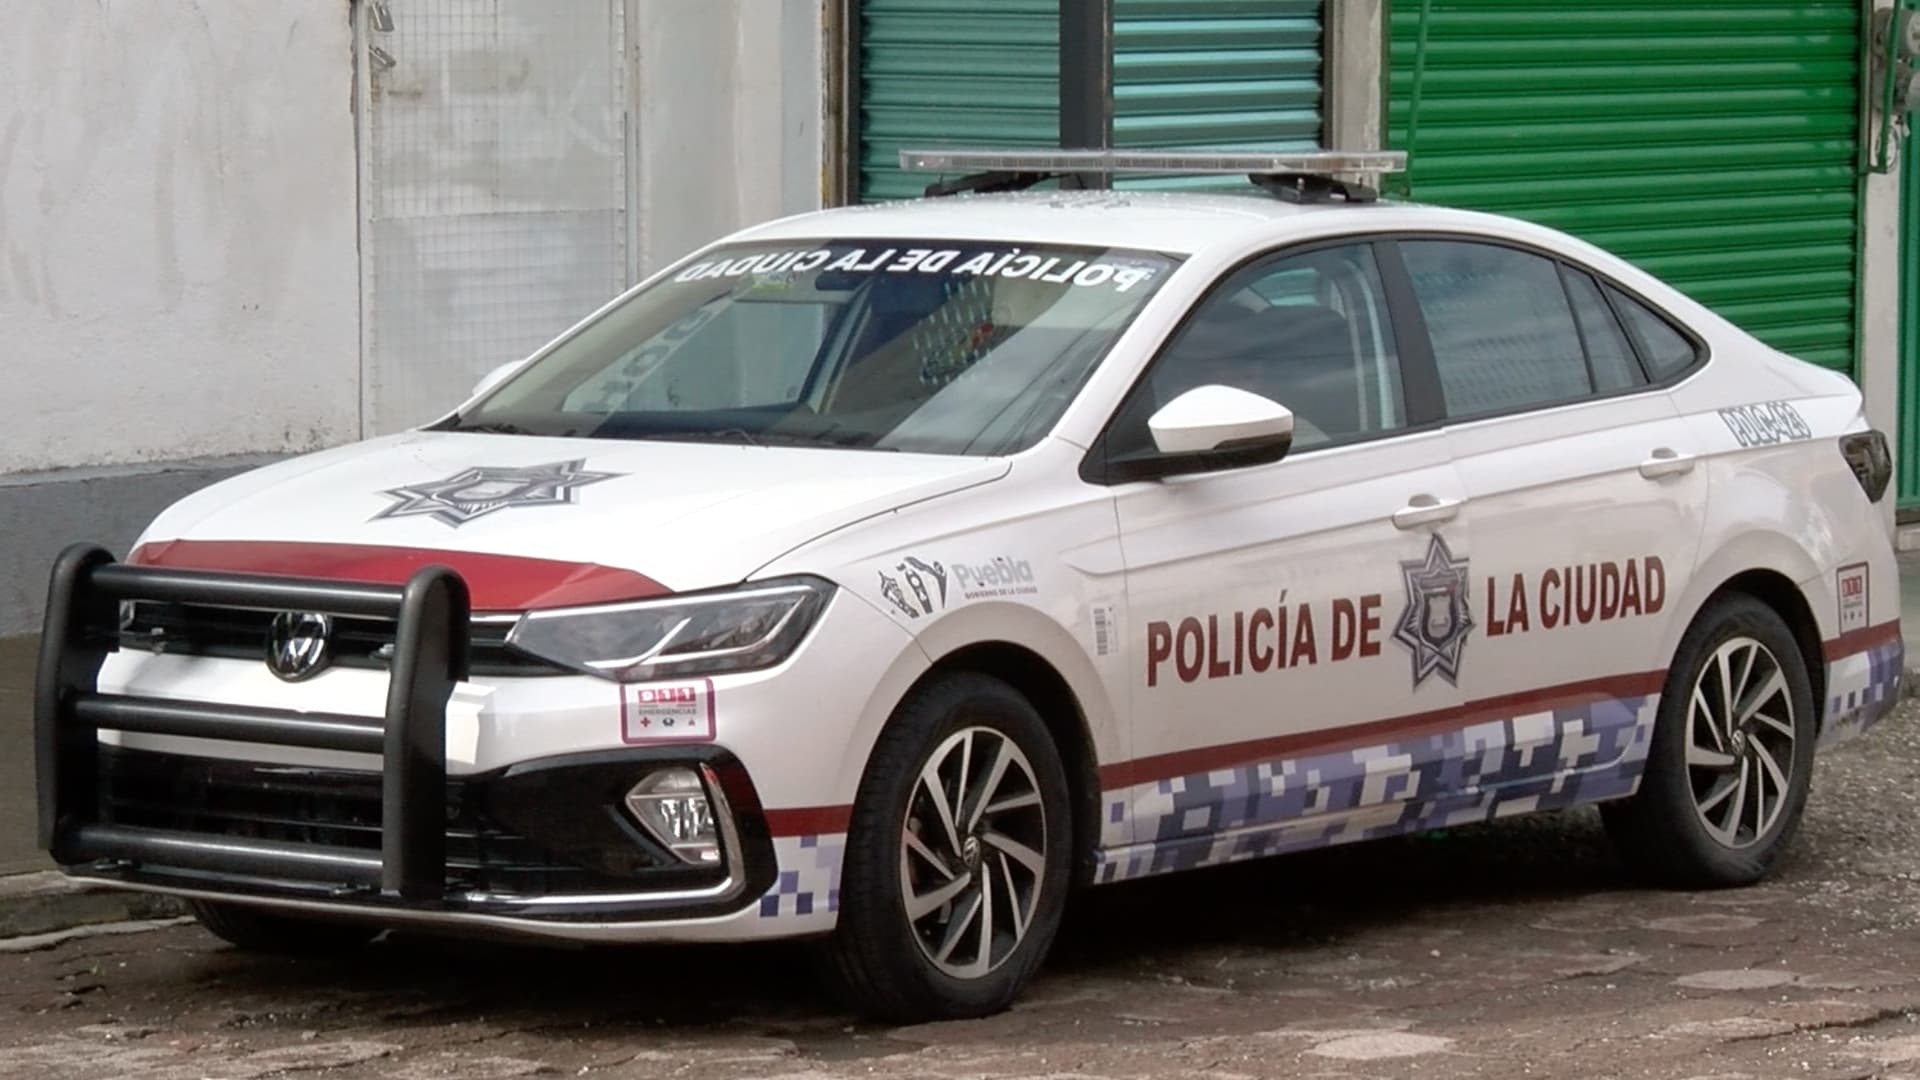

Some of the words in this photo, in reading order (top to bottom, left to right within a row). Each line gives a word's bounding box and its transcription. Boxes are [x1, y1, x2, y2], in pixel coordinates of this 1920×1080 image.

[952, 555, 1034, 589] Puebla
[1147, 589, 1318, 688] POLICÍA
[1331, 594, 1381, 661] DE
[1486, 573, 1530, 637] LA
[1539, 556, 1666, 630] CIUDAD
